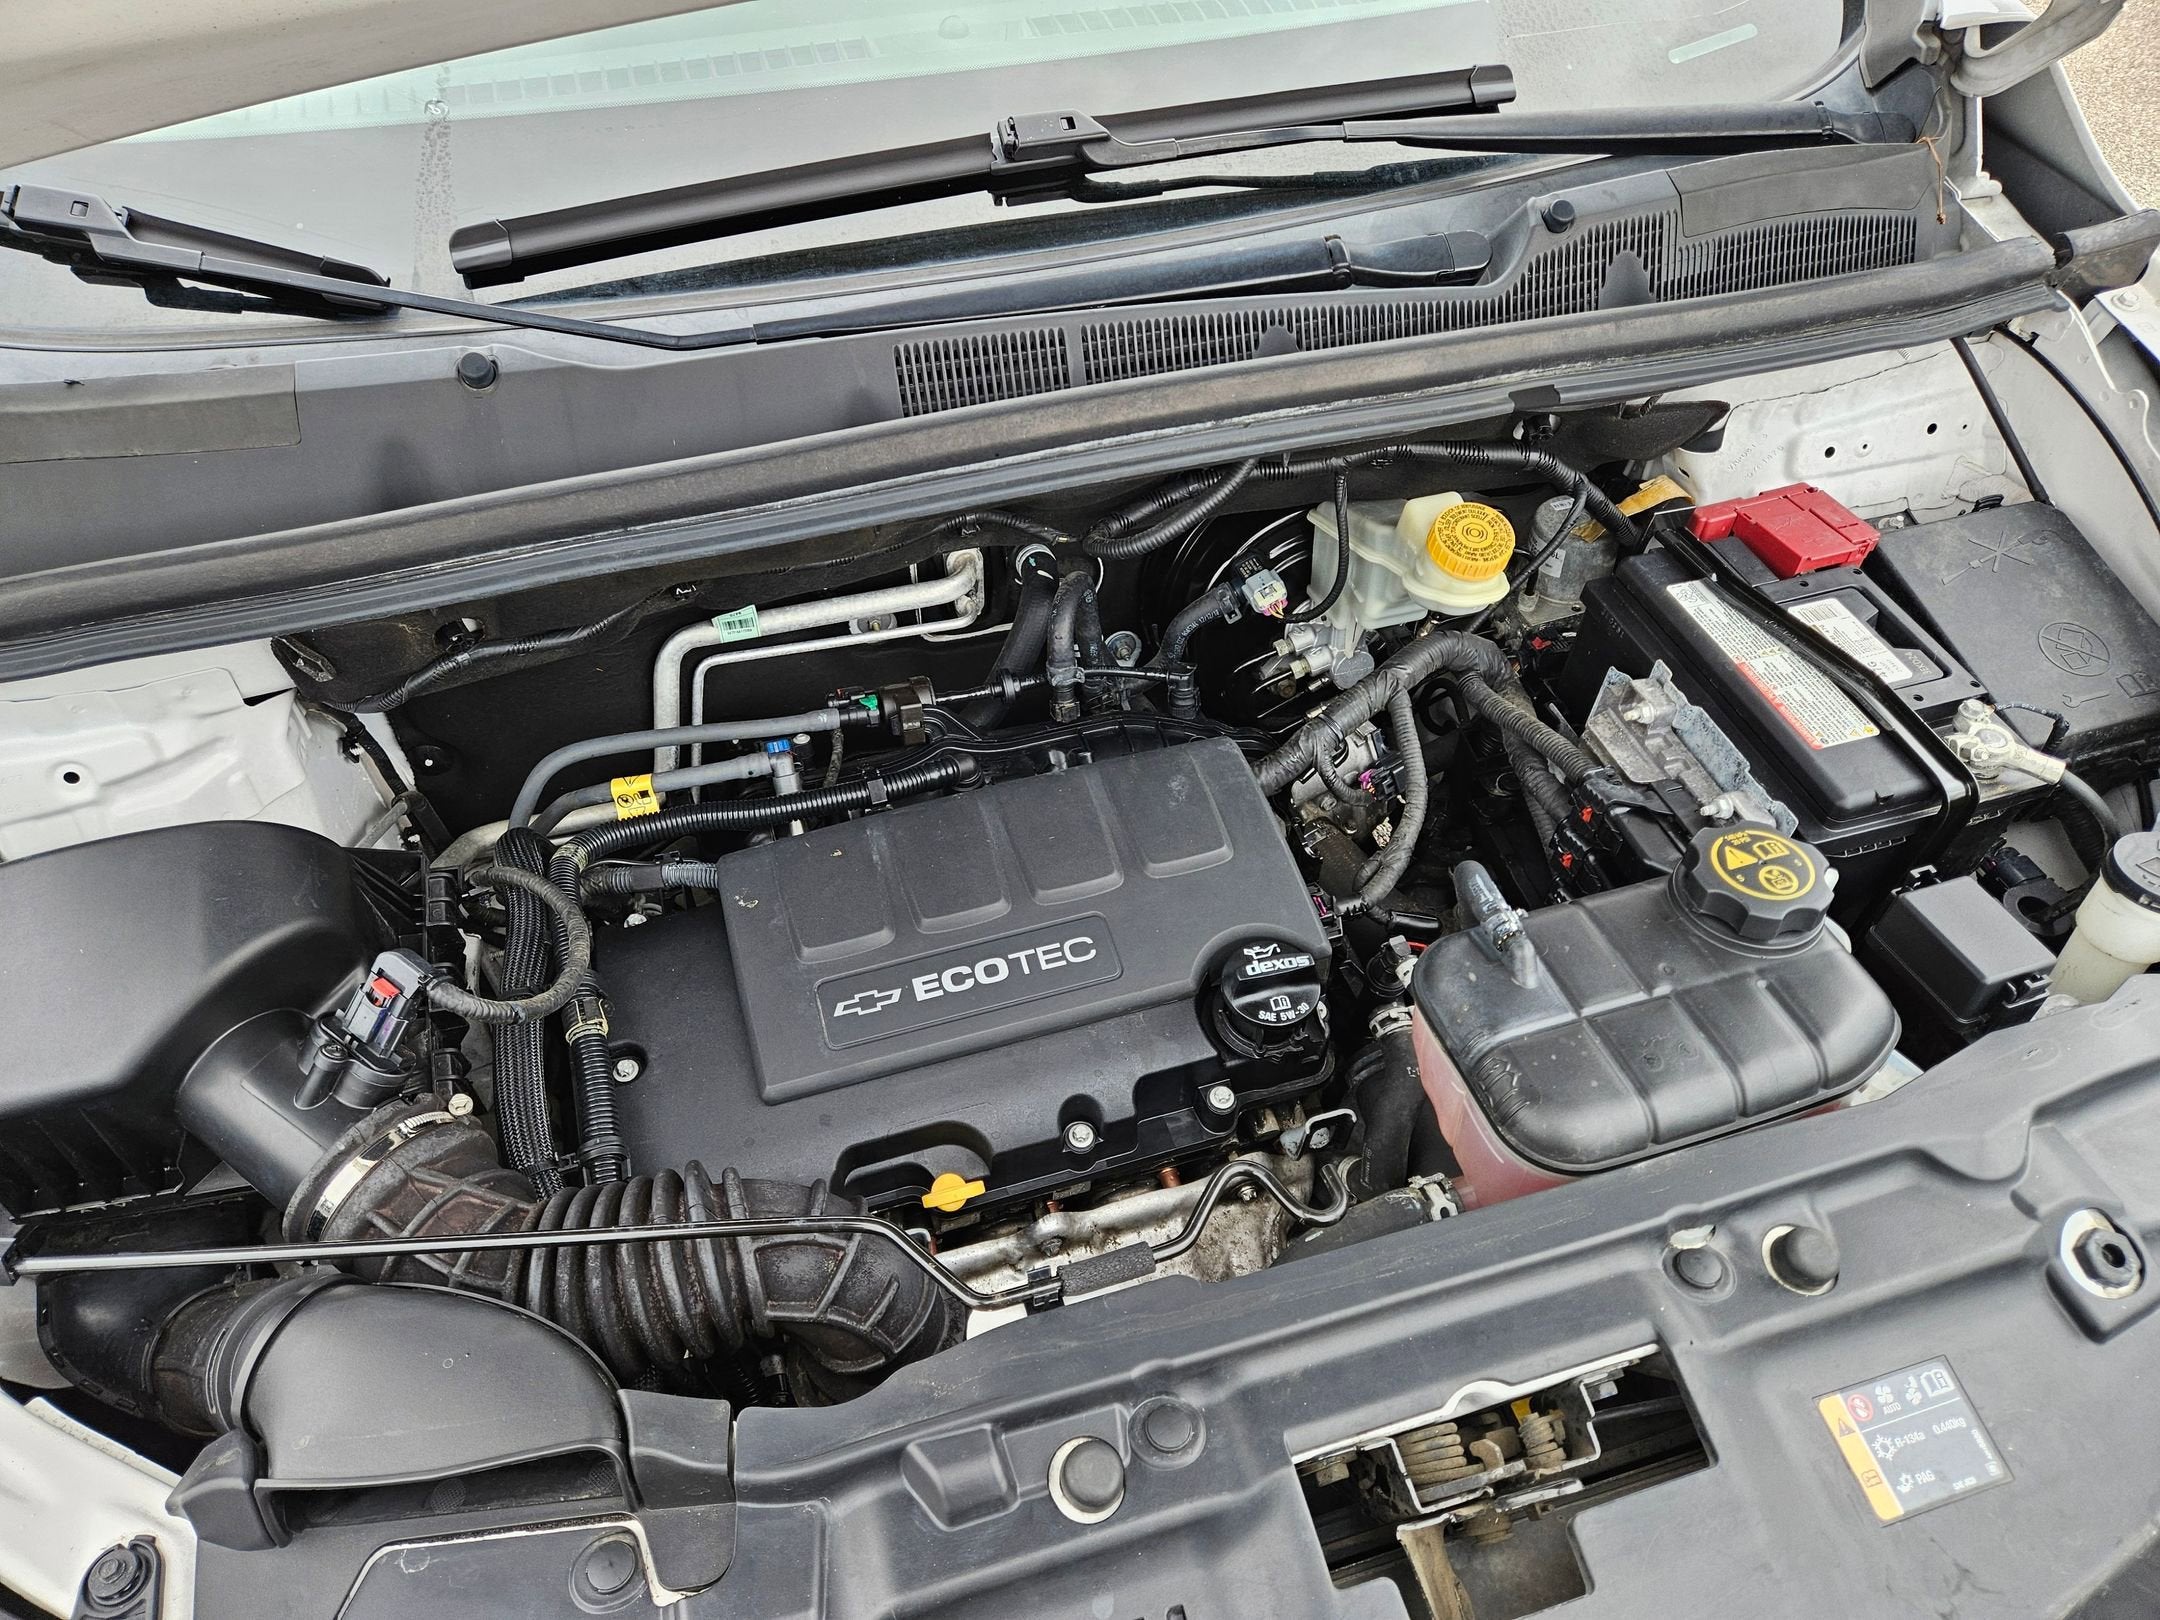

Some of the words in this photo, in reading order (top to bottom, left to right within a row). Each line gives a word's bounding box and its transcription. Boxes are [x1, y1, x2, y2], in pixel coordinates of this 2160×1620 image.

[912, 936, 1097, 1002] ECOTEC
[1245, 955, 1310, 976] dexos
[1258, 1010, 1278, 1021] SAE
[1280, 1002, 1310, 1021] 5W-30
[1883, 1402, 1902, 1415] AUTO
[1895, 1431, 1926, 1448] R-134a
[1932, 1416, 1967, 1435] 0.440kg
[1915, 1471, 1936, 1484] PAG
